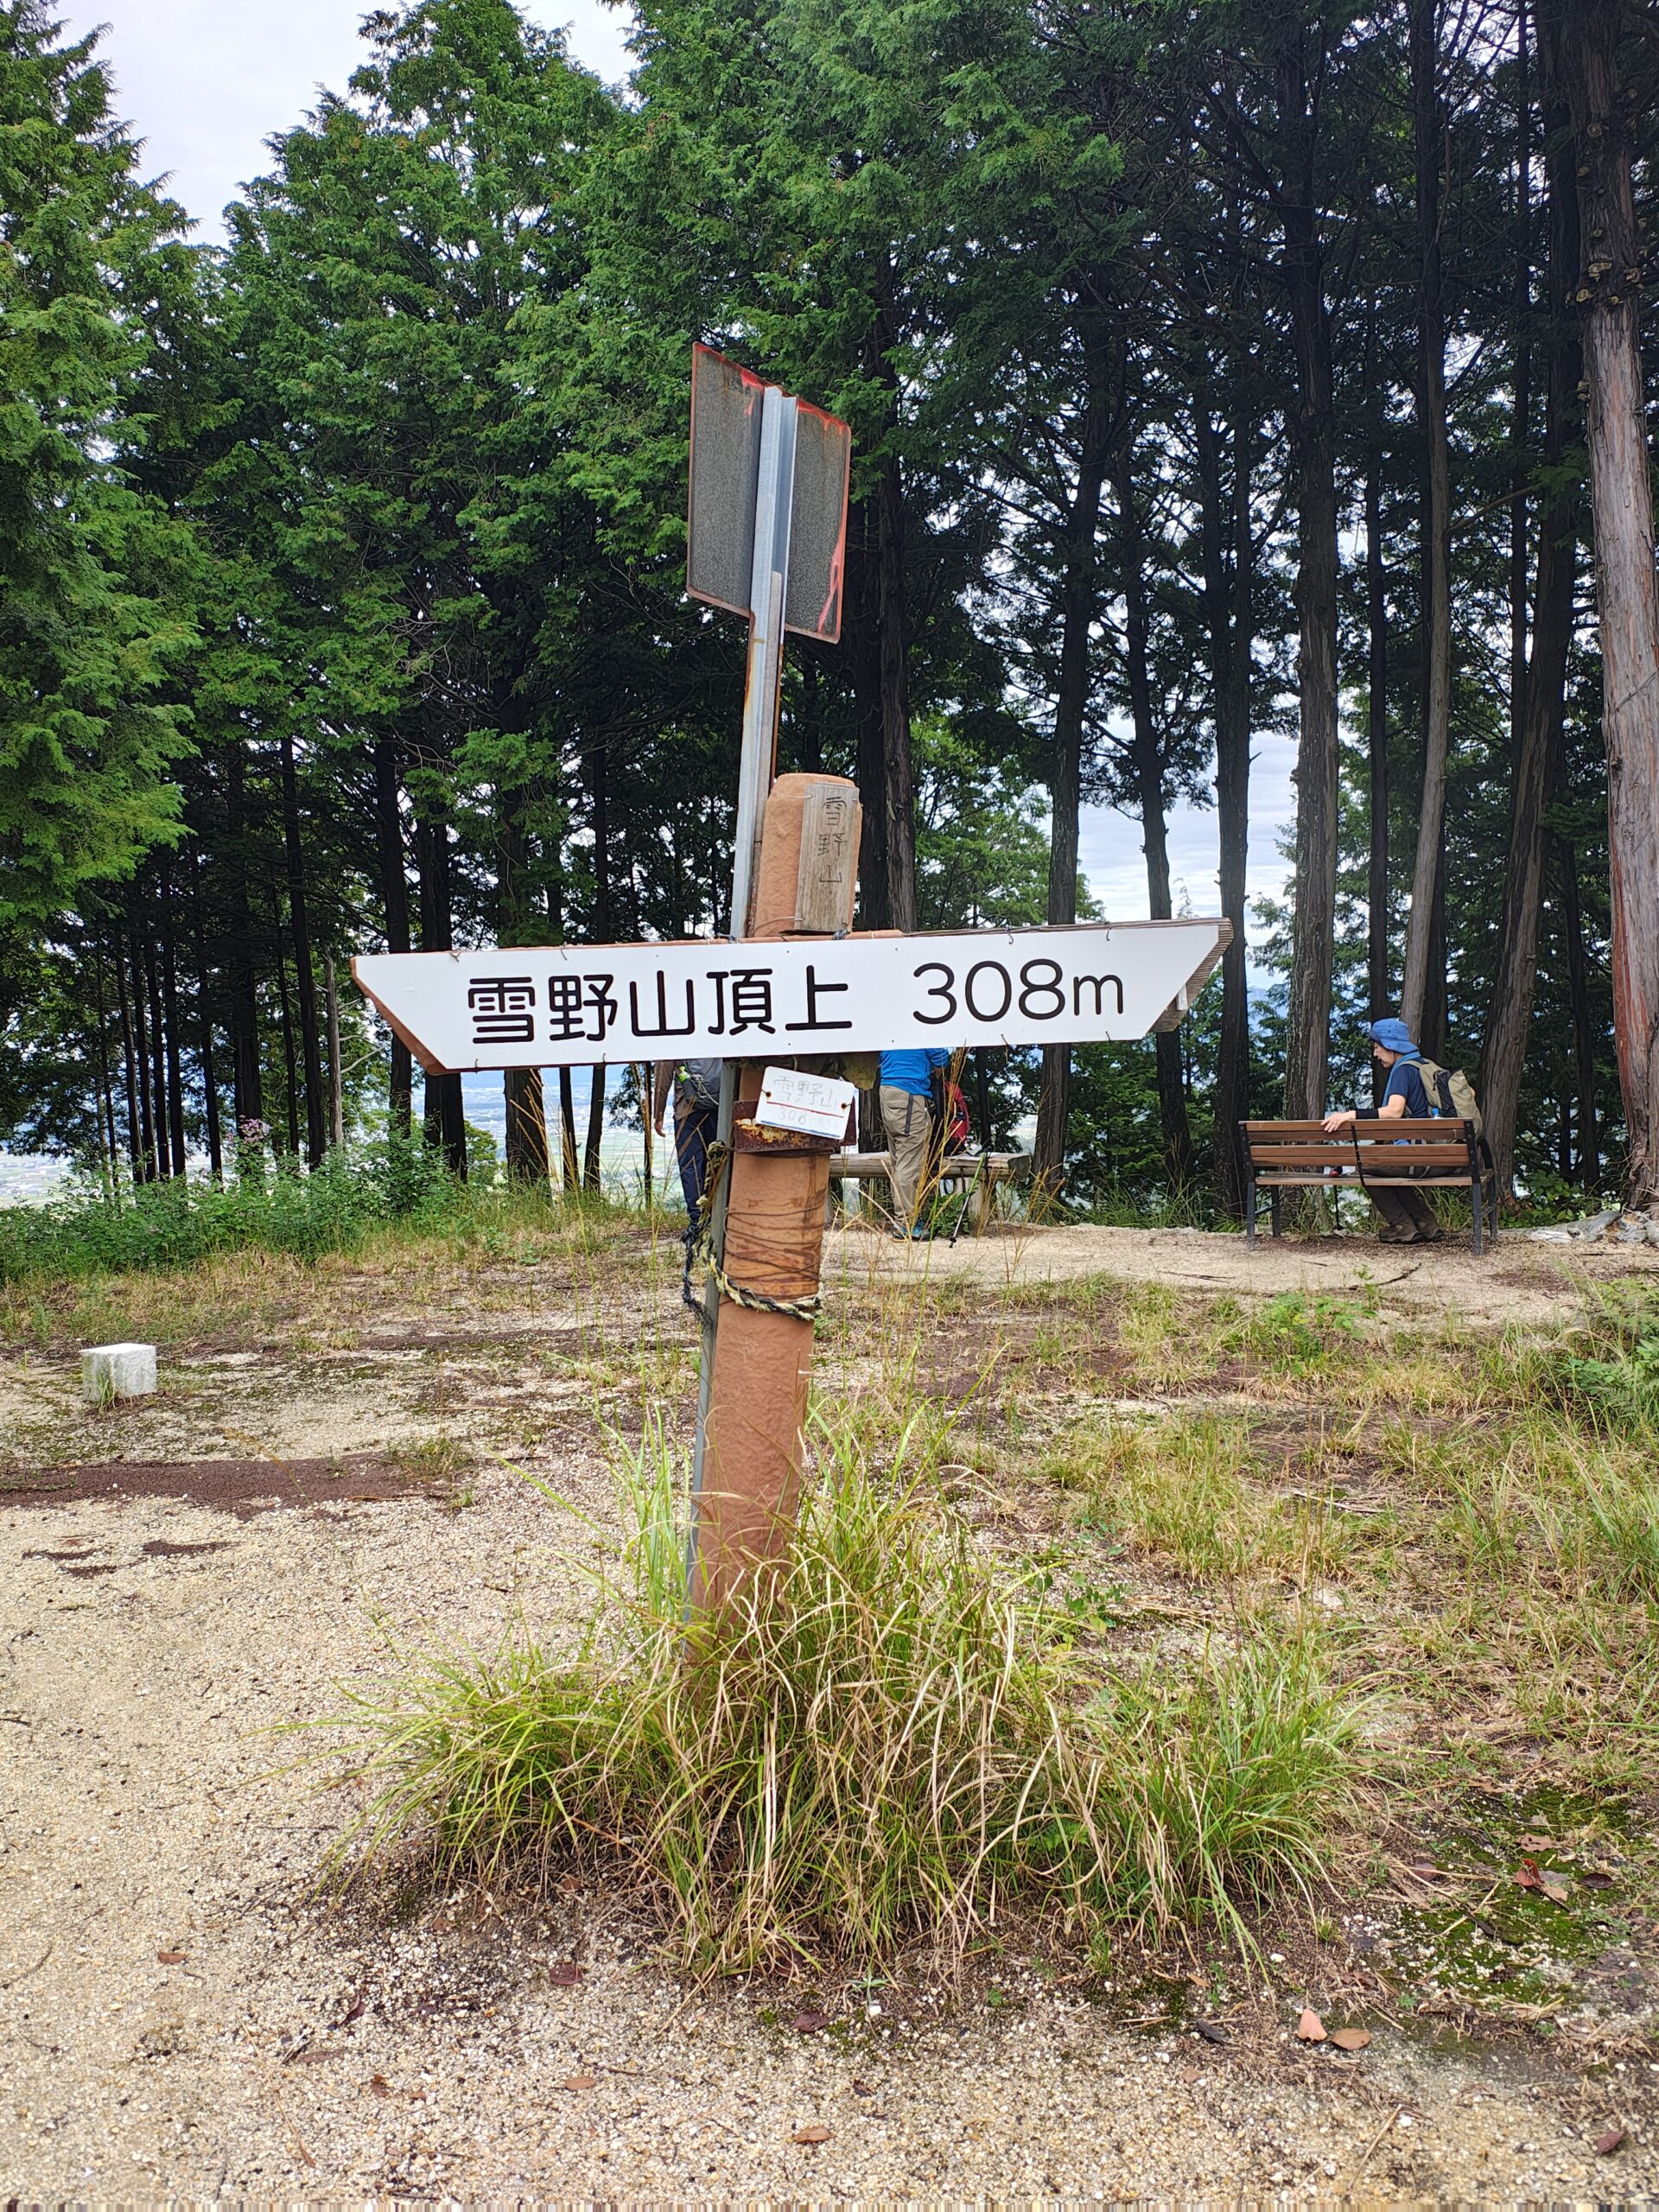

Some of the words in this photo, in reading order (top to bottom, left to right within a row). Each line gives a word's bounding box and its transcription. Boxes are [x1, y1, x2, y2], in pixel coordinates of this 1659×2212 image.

[817, 795, 847, 883] 雪野山
[467, 964, 854, 1045] 雪野山頂上
[912, 958, 1124, 1026] 308m
[773, 1075, 837, 1109] 雪野山
